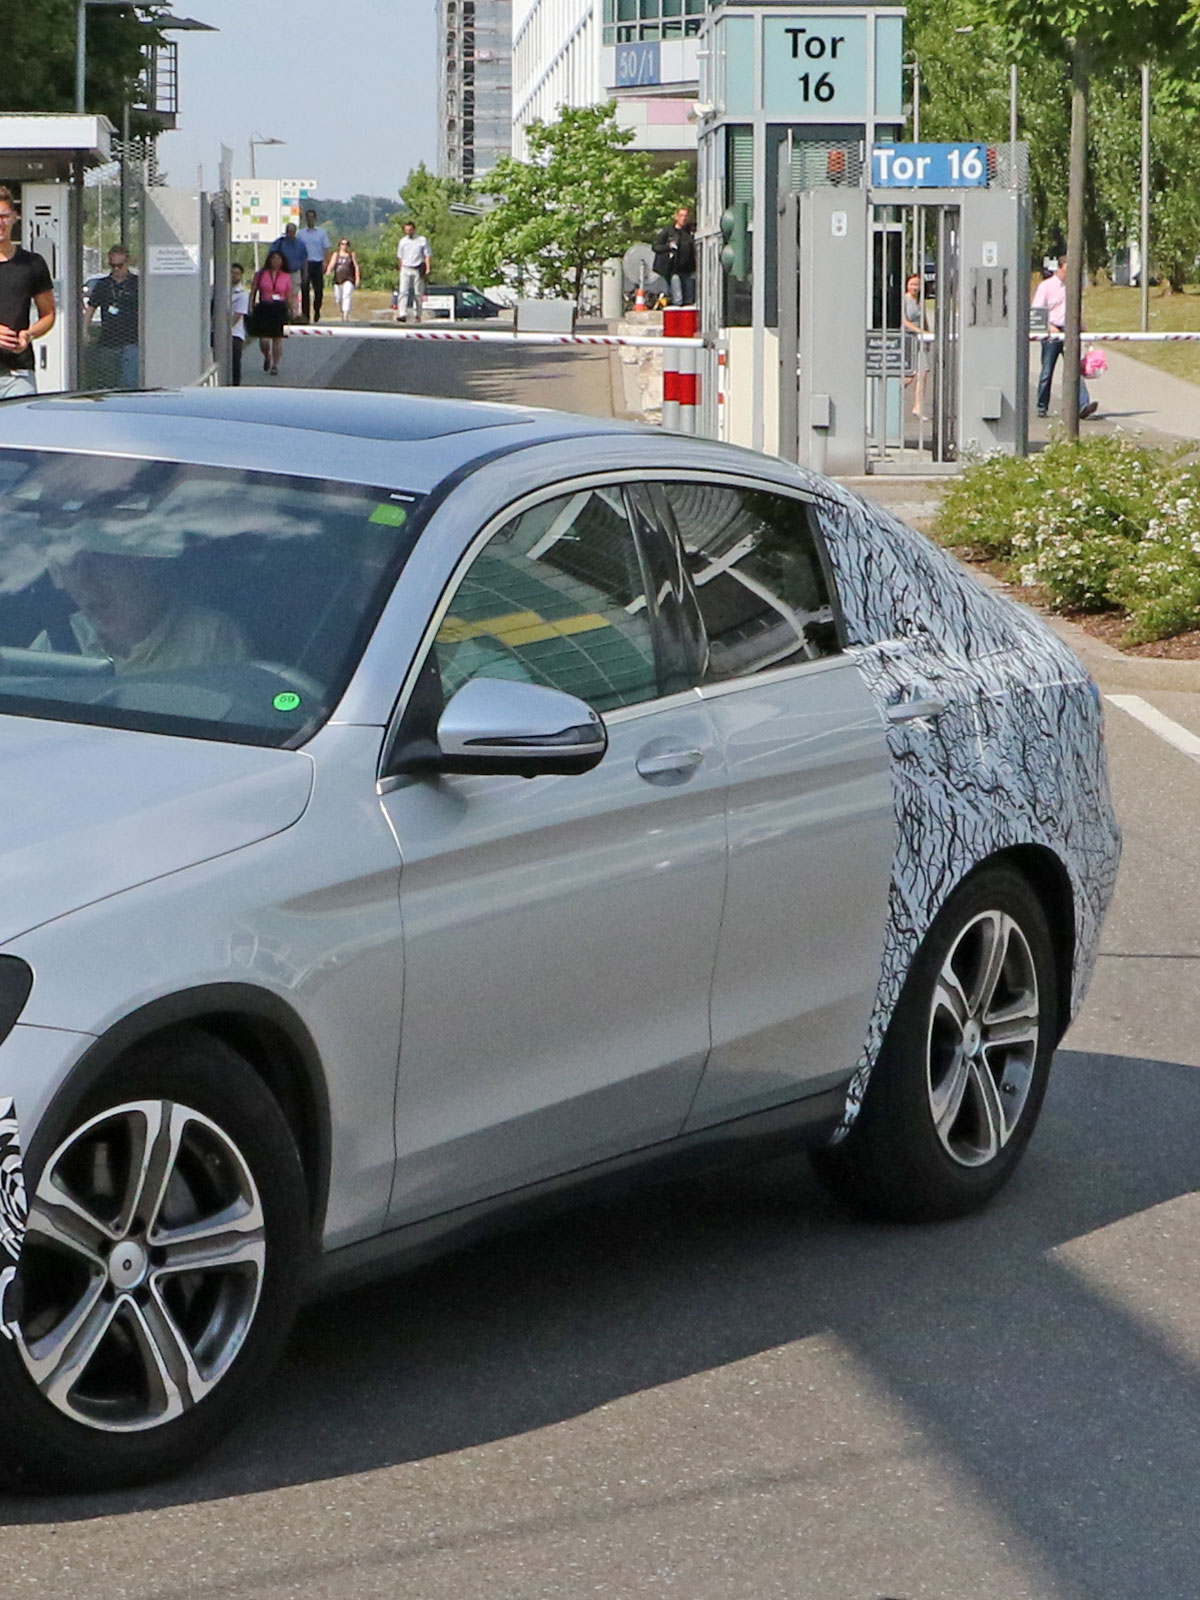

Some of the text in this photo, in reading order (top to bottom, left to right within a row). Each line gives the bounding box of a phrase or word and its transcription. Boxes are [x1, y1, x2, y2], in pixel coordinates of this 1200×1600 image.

[785, 28, 845, 58] Tor
[619, 49, 655, 85] 50/1
[798, 72, 836, 102] 16
[873, 149, 984, 180] Tor 16
